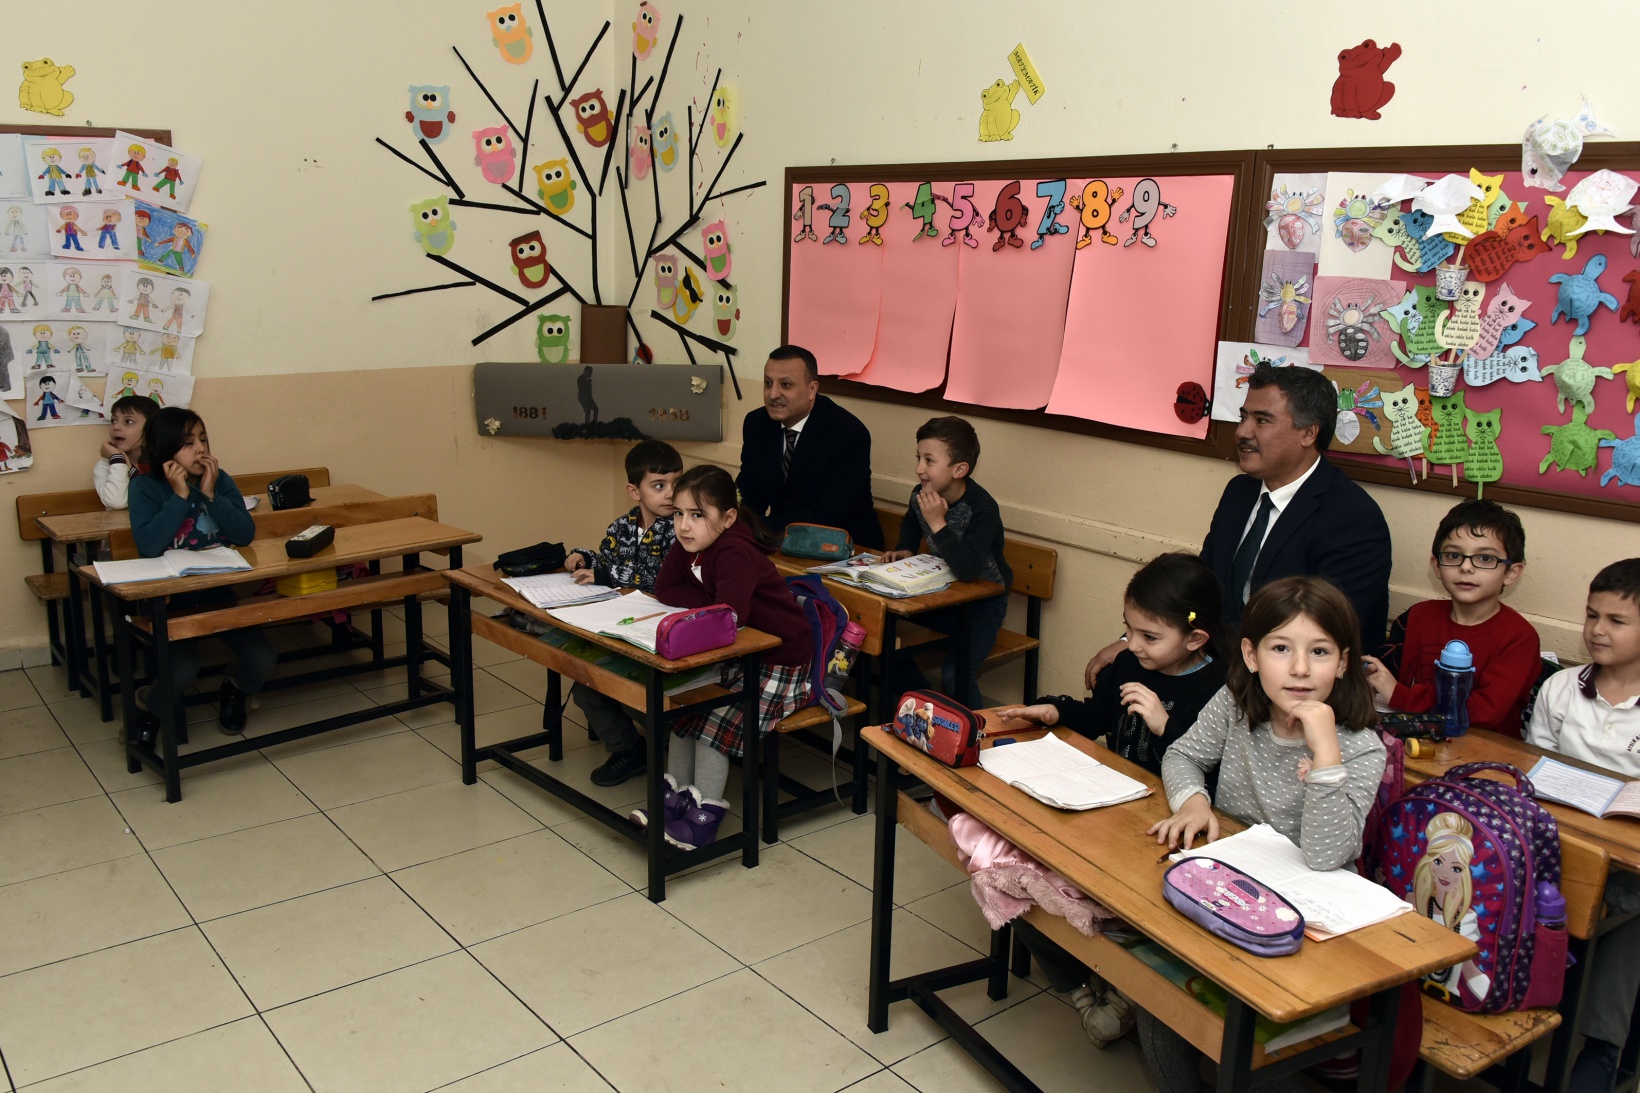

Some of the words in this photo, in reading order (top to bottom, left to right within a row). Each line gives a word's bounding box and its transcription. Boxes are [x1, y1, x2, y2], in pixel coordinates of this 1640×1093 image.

[799, 186, 813, 226] 1
[829, 183, 850, 227] 2
[867, 184, 890, 227] 3
[912, 182, 936, 227] 4
[949, 183, 974, 230] 5
[994, 181, 1020, 231] 6
[1037, 179, 1066, 235] 7
[1081, 180, 1110, 228] 8
[1132, 178, 1160, 230] 9
